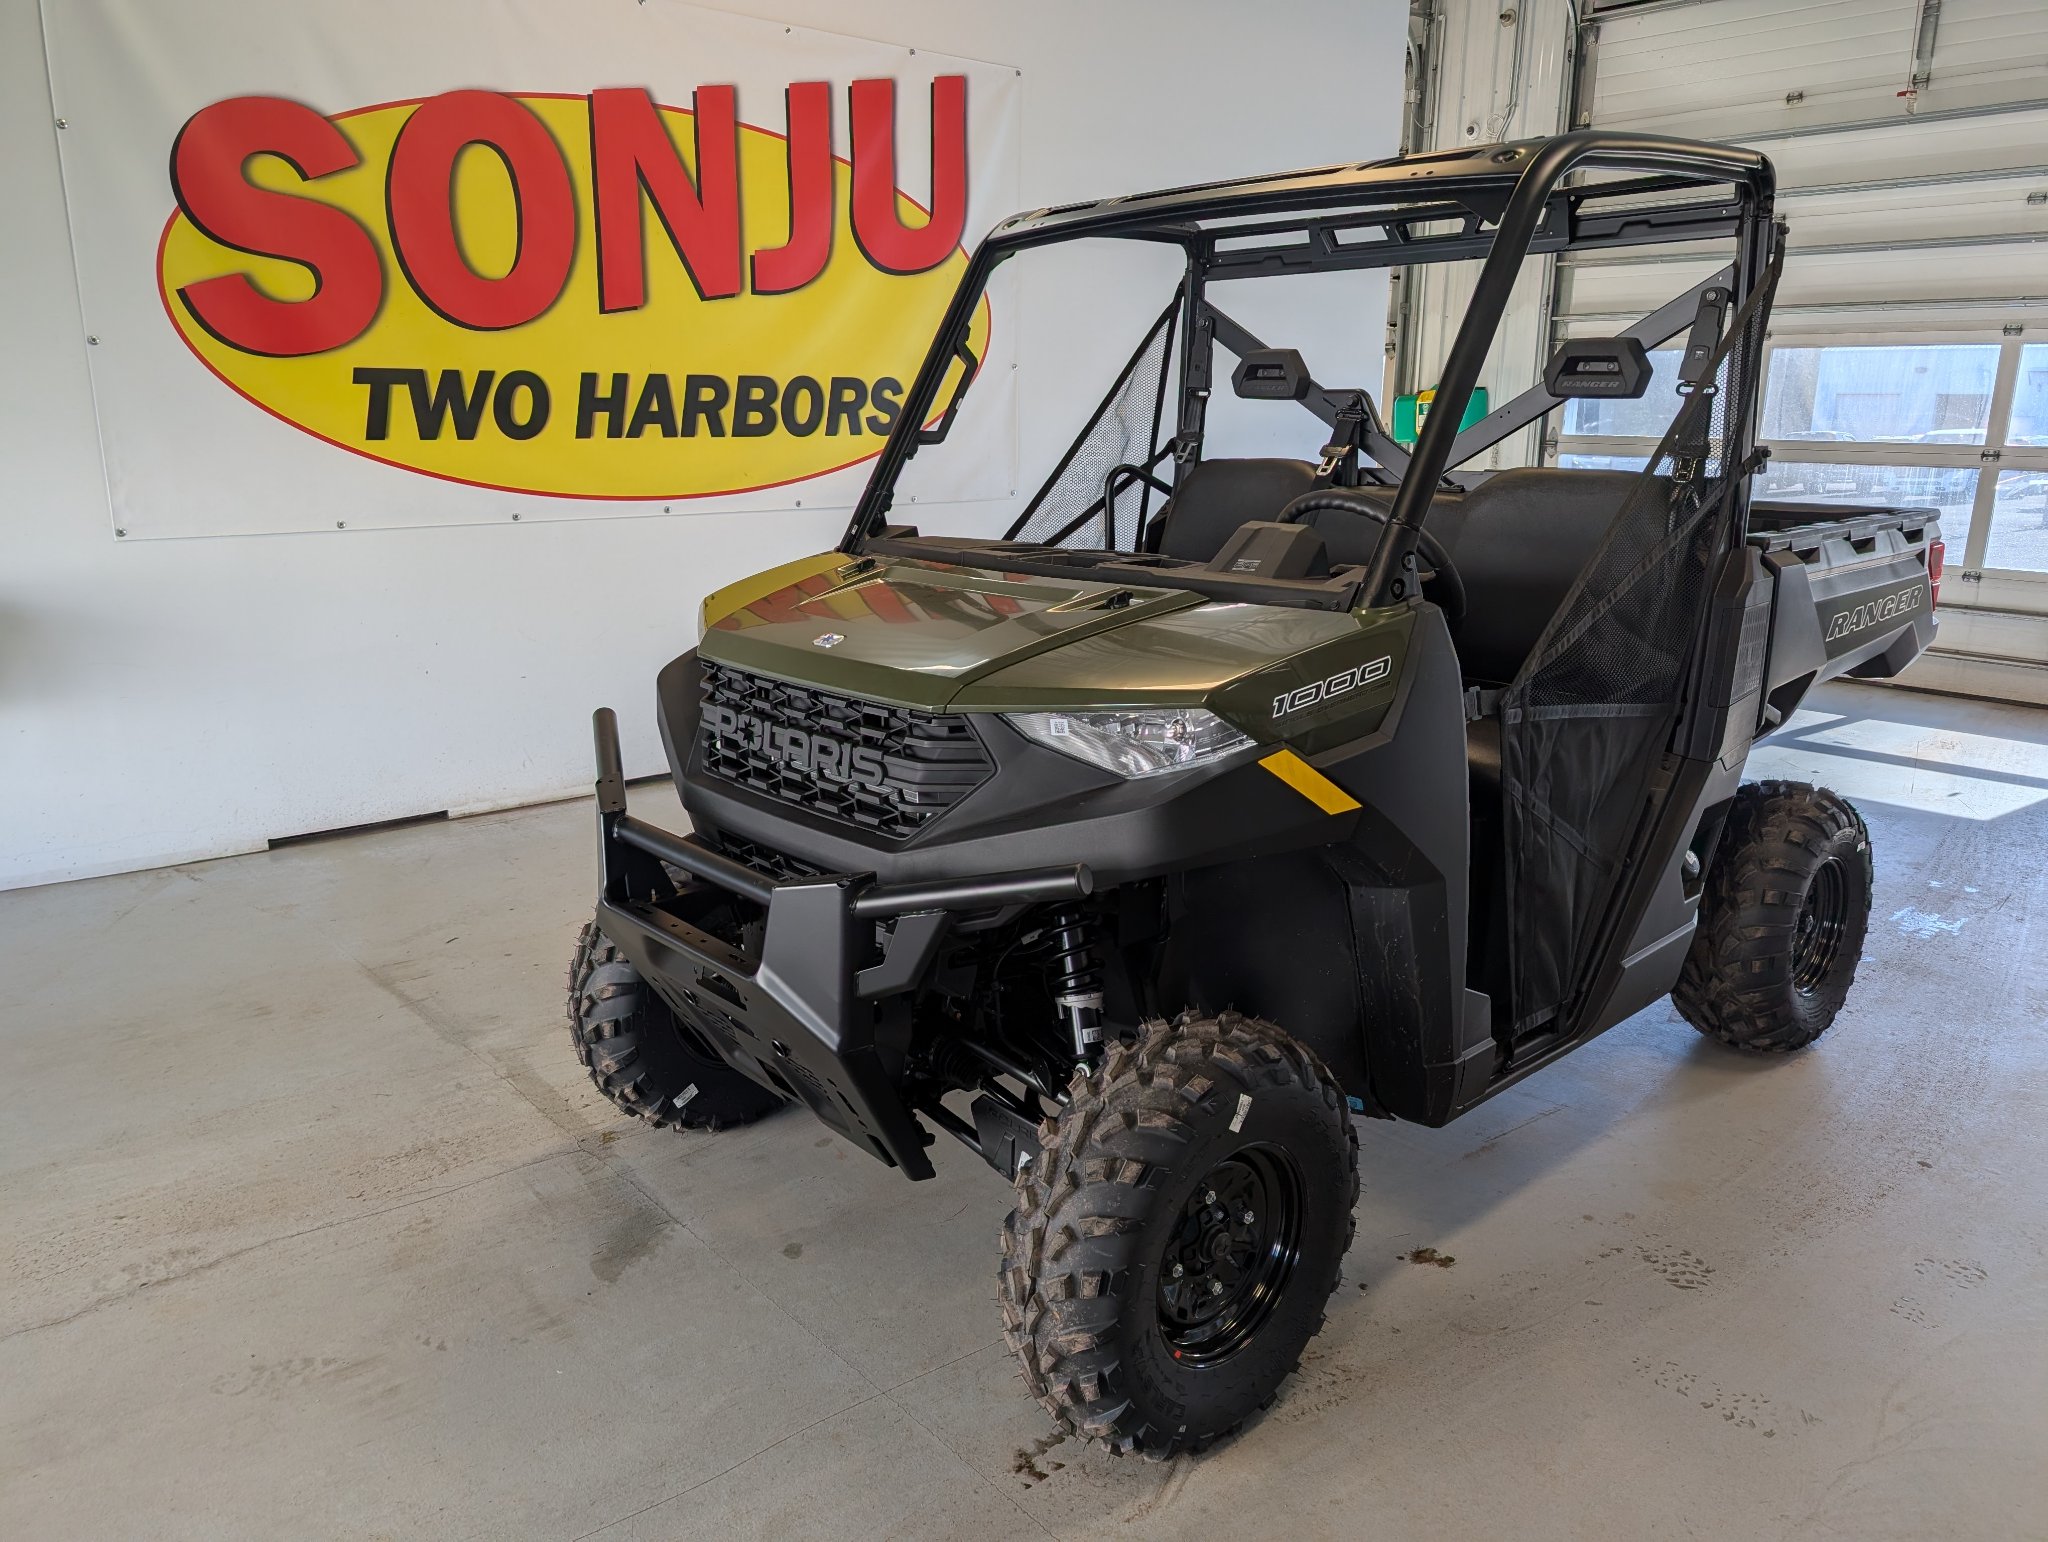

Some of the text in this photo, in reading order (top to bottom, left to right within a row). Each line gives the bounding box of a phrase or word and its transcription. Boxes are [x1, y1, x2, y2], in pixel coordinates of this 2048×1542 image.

[169, 75, 968, 358] SONJU
[353, 367, 903, 441] TWO HARBORS
[1825, 584, 1924, 642] RANGER
[1272, 655, 1392, 719] 1000
[715, 705, 885, 786] POLARIS
